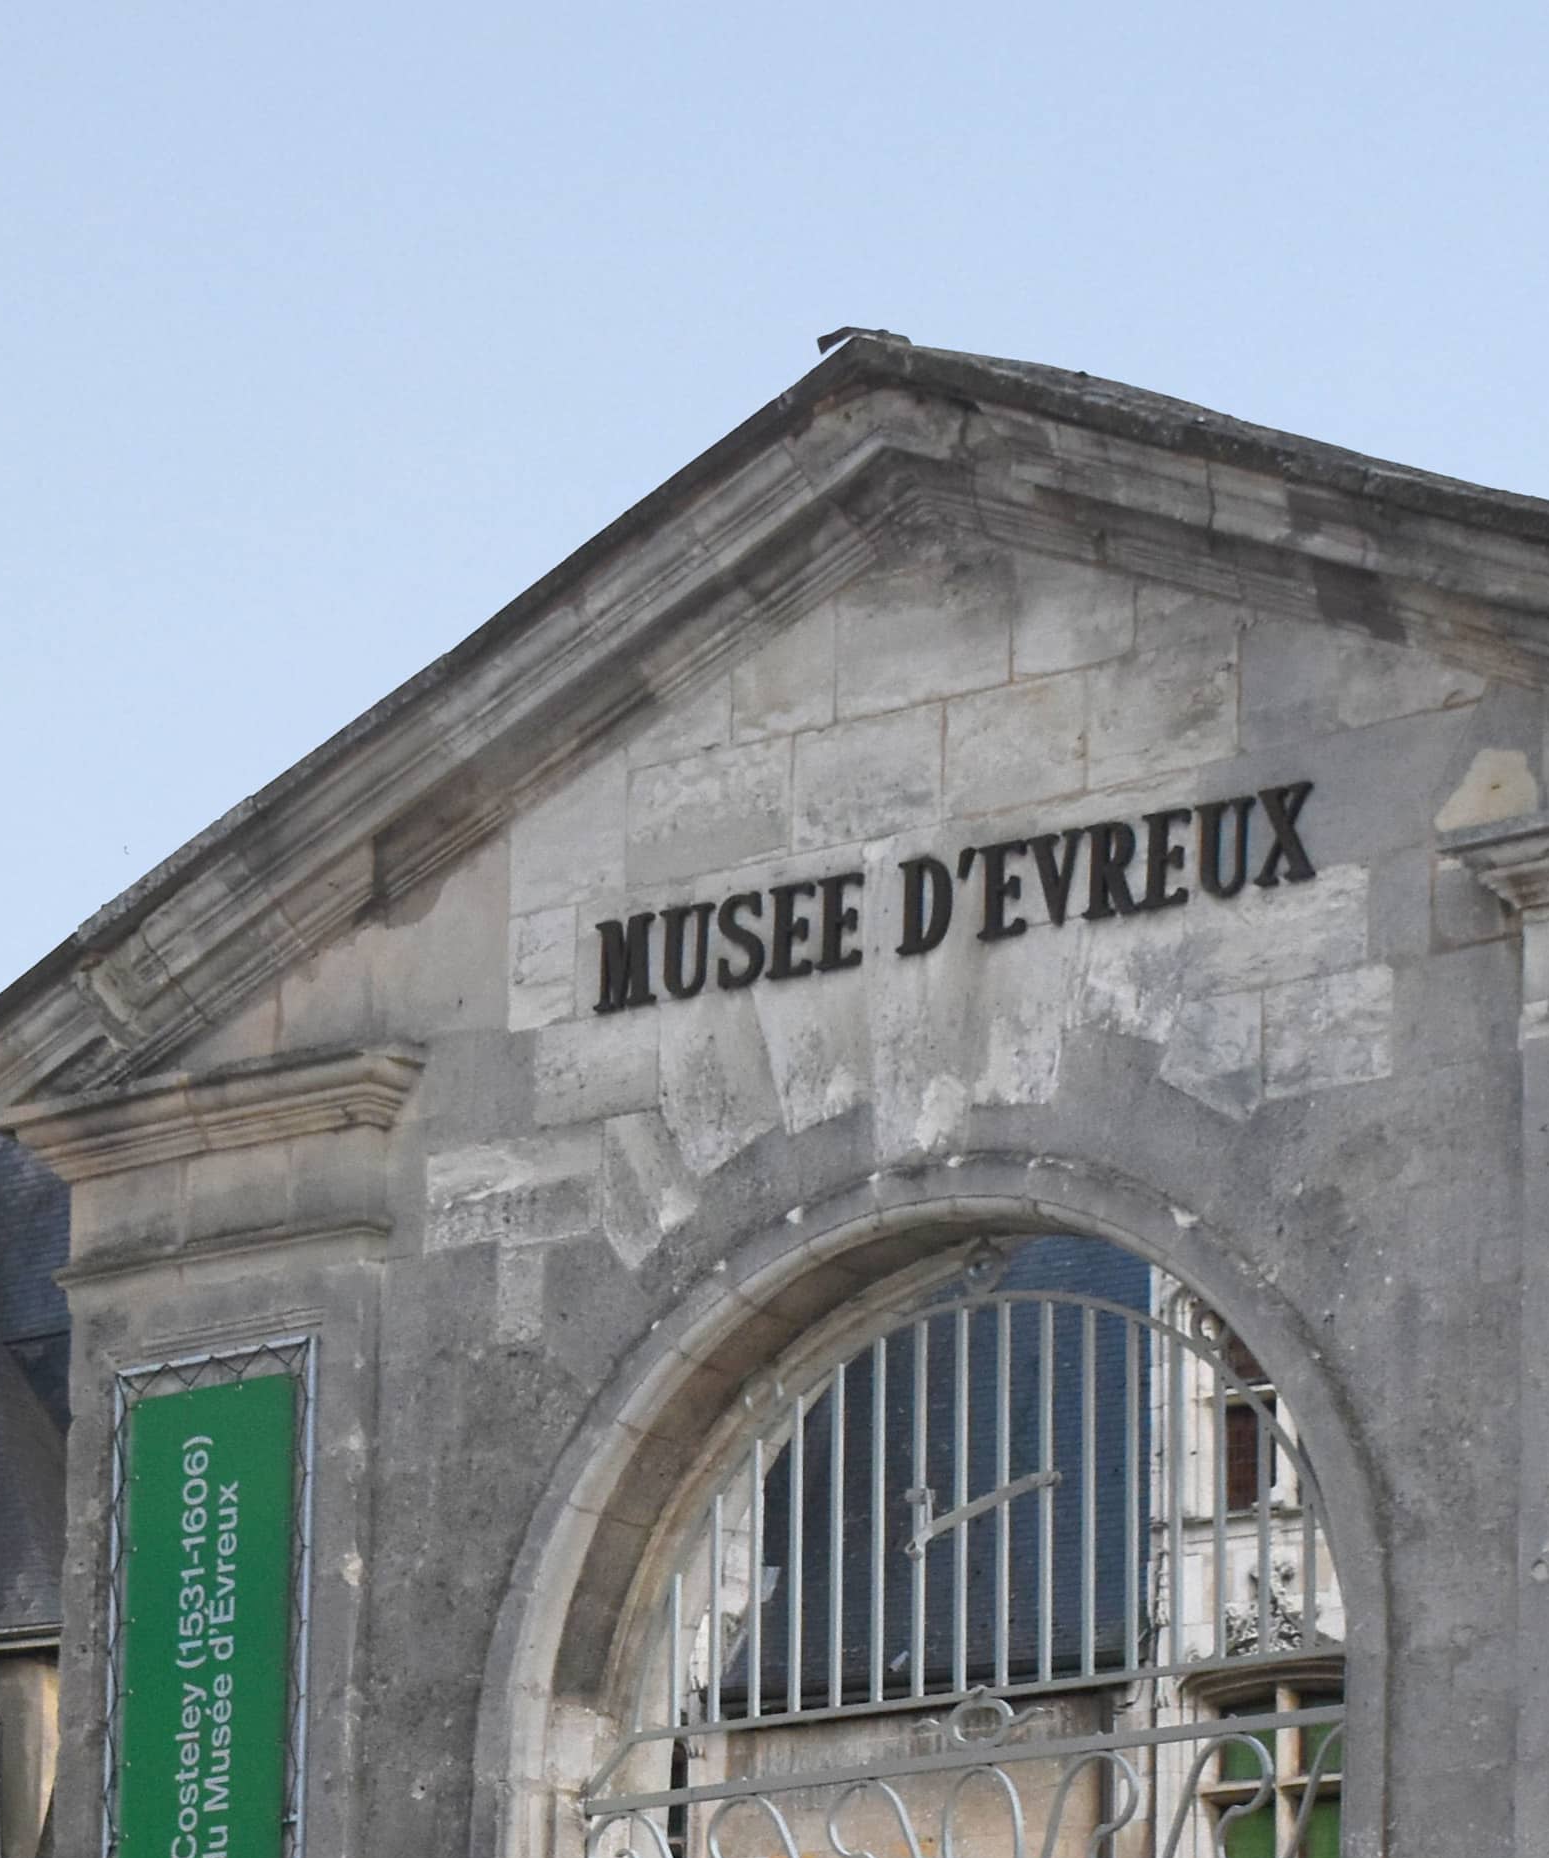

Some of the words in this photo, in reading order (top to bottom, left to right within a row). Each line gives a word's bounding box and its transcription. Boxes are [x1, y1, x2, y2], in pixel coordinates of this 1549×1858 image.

[594, 872, 864, 1013] MUSEE
[895, 780, 1317, 957] D'EVREUX
[176, 1435, 214, 1669] (1531-1606)
[204, 1481, 239, 1660] d'Évreux
[203, 1673, 233, 1812] Musée
